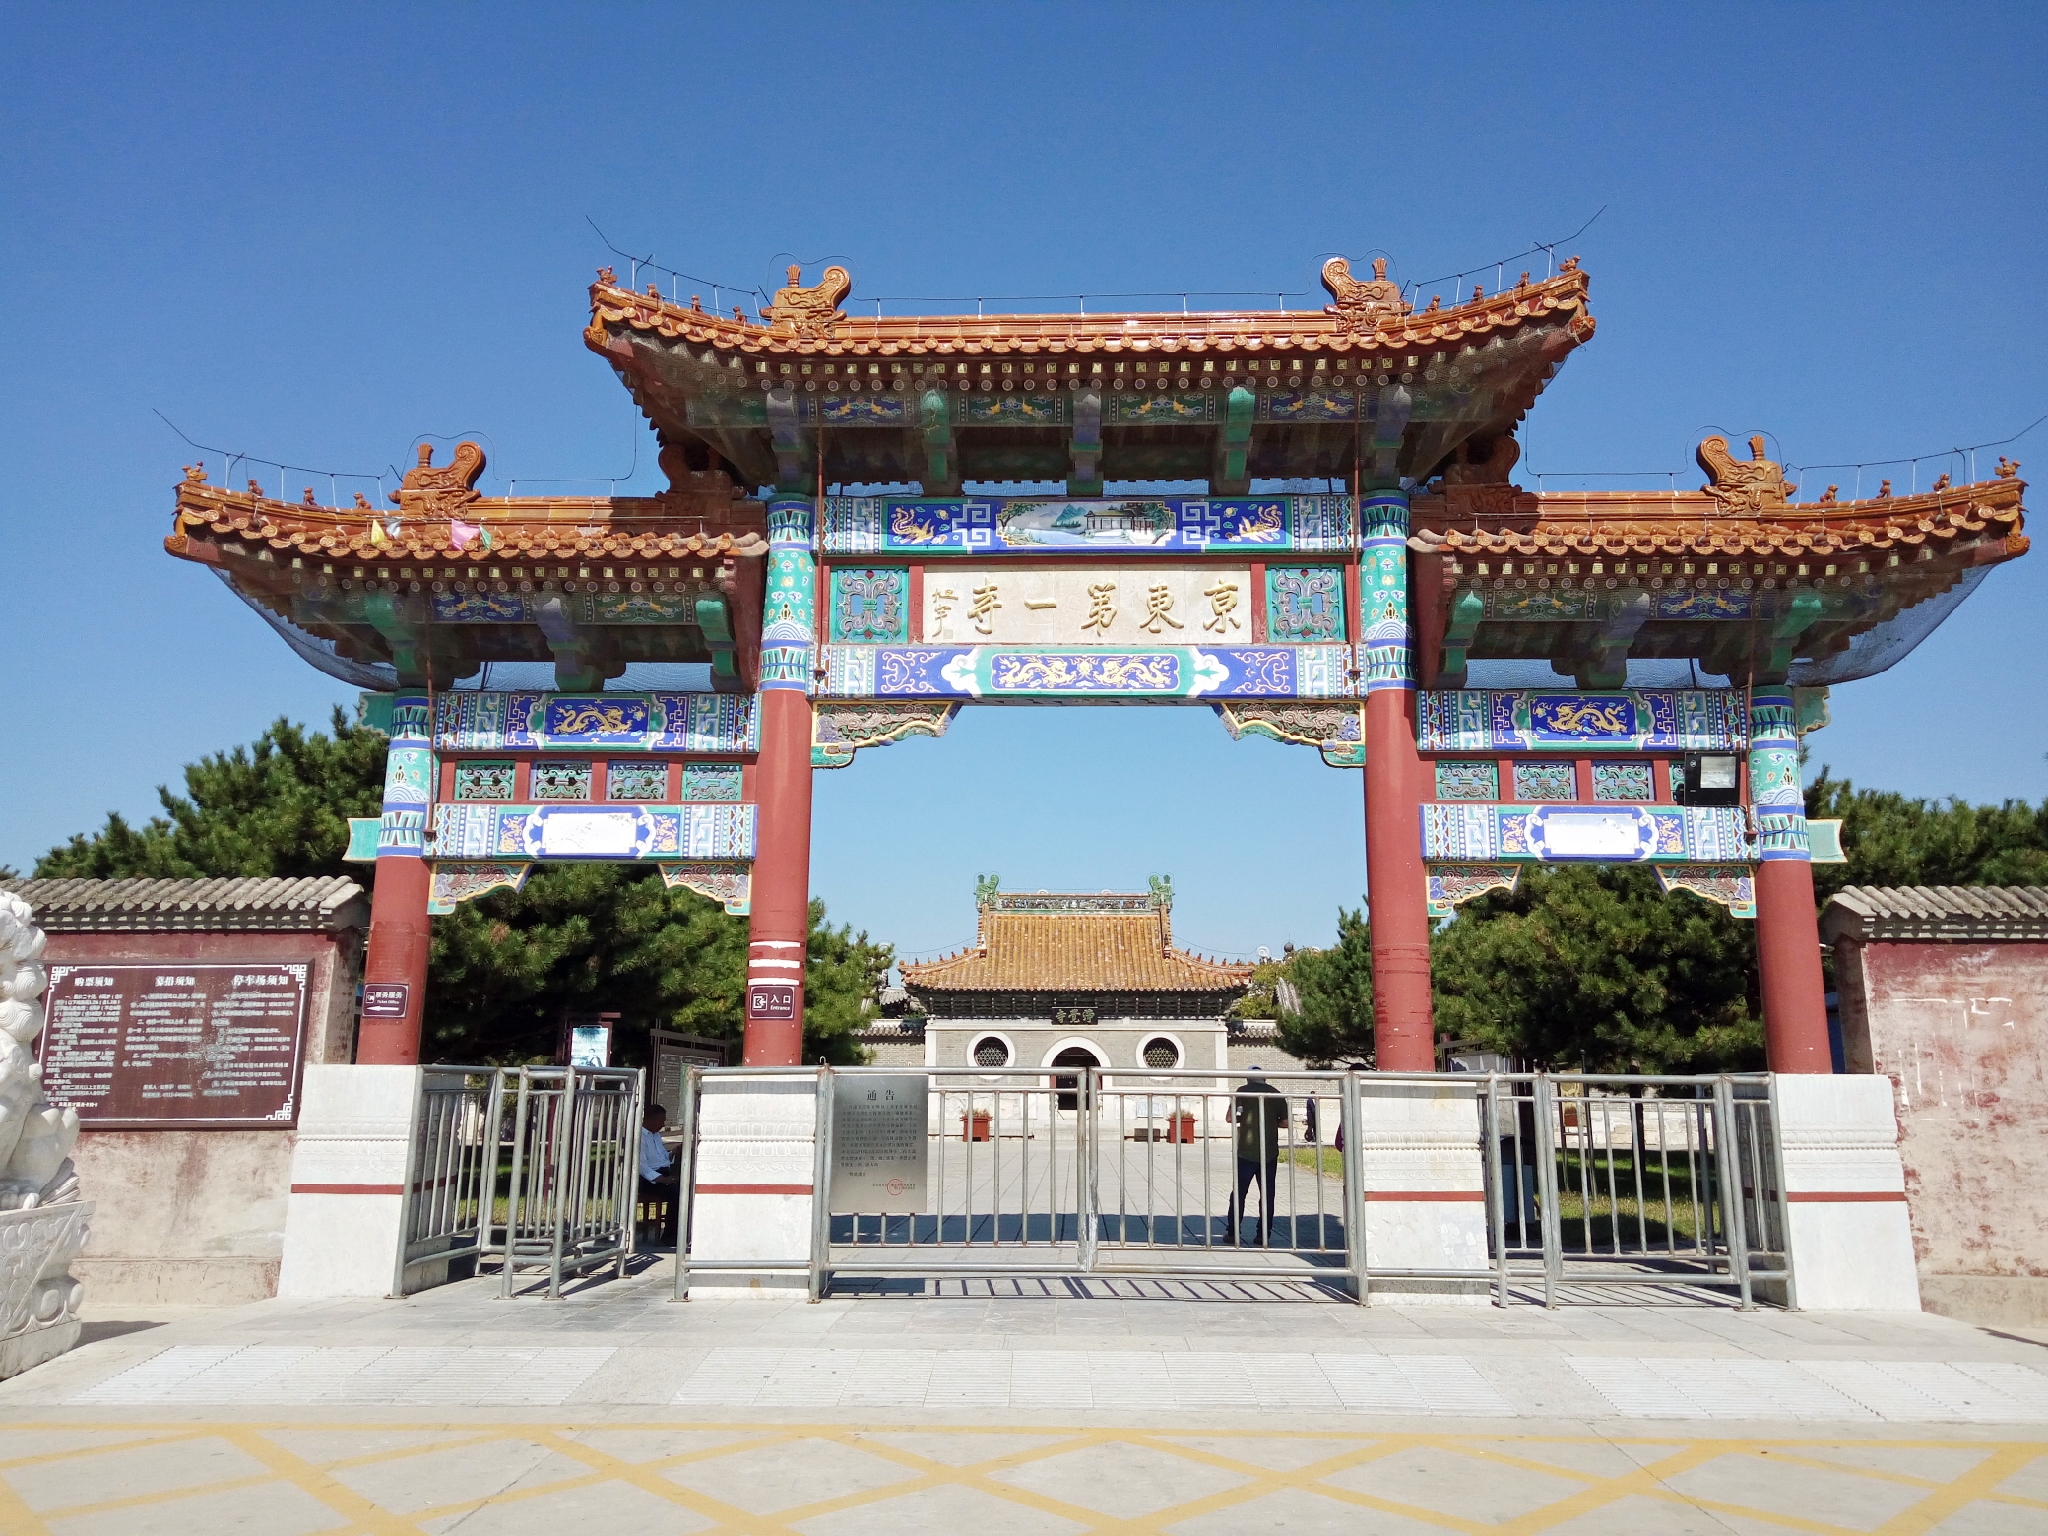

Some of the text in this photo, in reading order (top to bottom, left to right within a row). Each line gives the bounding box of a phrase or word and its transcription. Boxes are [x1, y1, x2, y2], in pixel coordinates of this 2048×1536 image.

[233, 975, 289, 987] 停车场须知
[770, 994, 791, 1004] 入口
[866, 1089, 895, 1101] 通告
